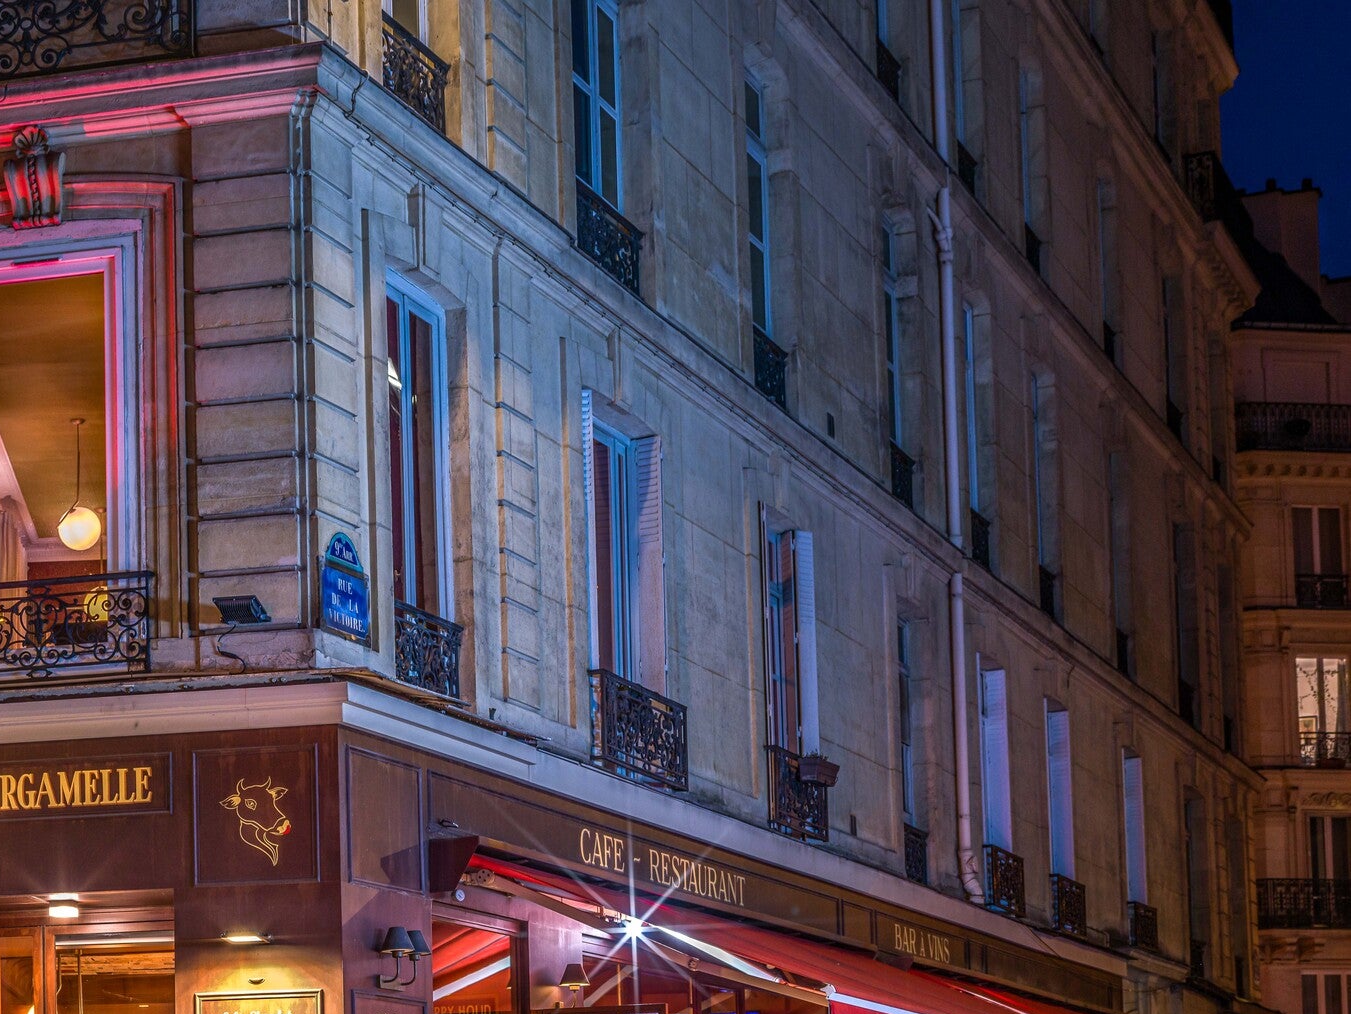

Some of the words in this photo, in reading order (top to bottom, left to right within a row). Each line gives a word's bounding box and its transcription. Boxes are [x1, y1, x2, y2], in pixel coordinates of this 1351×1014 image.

[338, 578, 353, 594] RUE
[332, 592, 341, 607] DE
[349, 599, 358, 614] LA
[579, 826, 626, 873] CAFE
[648, 847, 747, 907] RESTAURANT
[894, 923, 916, 952] BAR
[928, 933, 950, 964] VINS
